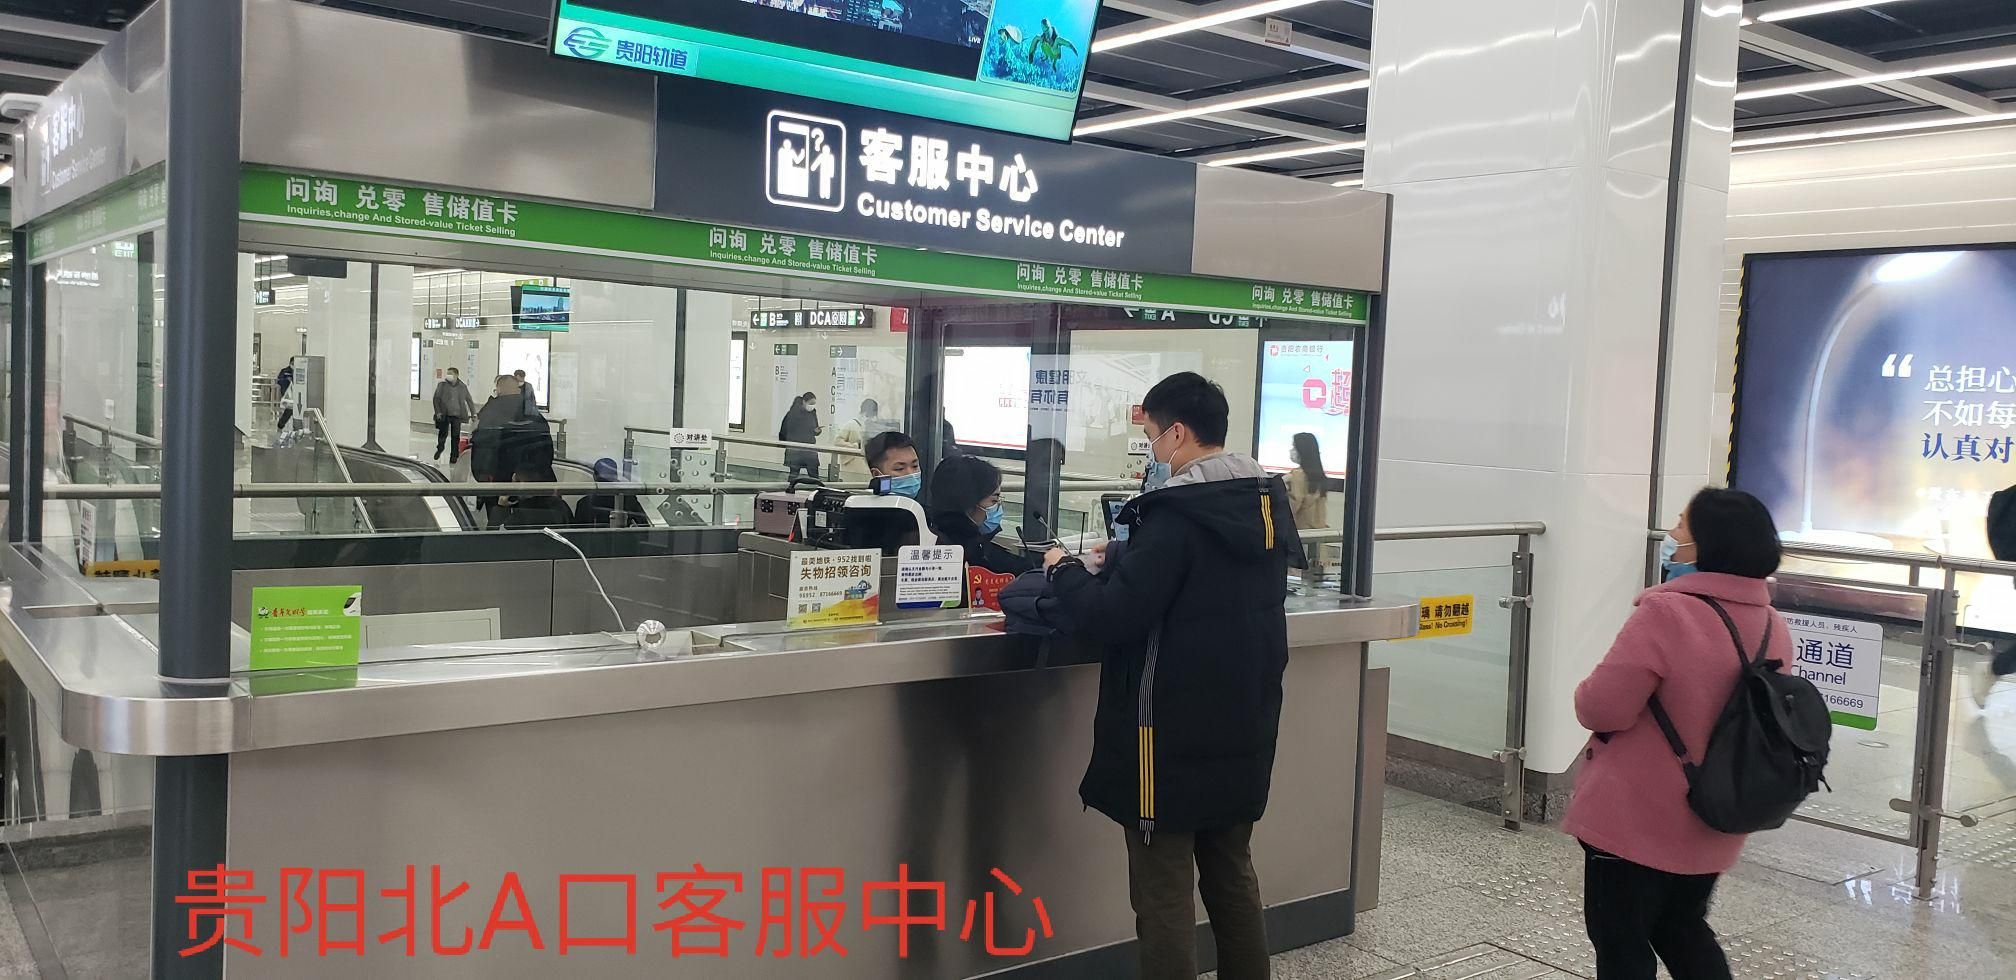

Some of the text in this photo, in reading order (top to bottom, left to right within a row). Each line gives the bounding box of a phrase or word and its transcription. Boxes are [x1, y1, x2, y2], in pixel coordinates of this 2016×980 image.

[616, 39, 687, 70] 贵阳轨道
[859, 127, 1039, 202] 客服中心
[285, 177, 519, 225] 问询 兑零 售储值卡
[287, 204, 516, 238] Inquiries,change And Stored-value Ticket Selling
[856, 191, 1126, 248] Customer Service Center
[709, 226, 878, 266] 问询 兑零 售储值卡
[710, 250, 876, 277] Inquiries,change And Stored-value Ticket Selling
[1016, 262, 1144, 292] 问询 兑零 售储值卡
[1062, 287, 1074, 295] And
[1108, 291, 1124, 299] Ticket
[1251, 284, 1354, 310] 问询 兑零 售储值卡
[1923, 364, 2016, 393] 总担心
[1921, 399, 2016, 430] 不如每
[686, 433, 708, 441] 对讲处
[1921, 432, 2015, 464] 认真对
[910, 548, 953, 561] 温馨提示
[800, 564, 872, 580] 失物招领咨询
[1435, 603, 1469, 618] 请勿翻越
[1796, 637, 1855, 670] 通道
